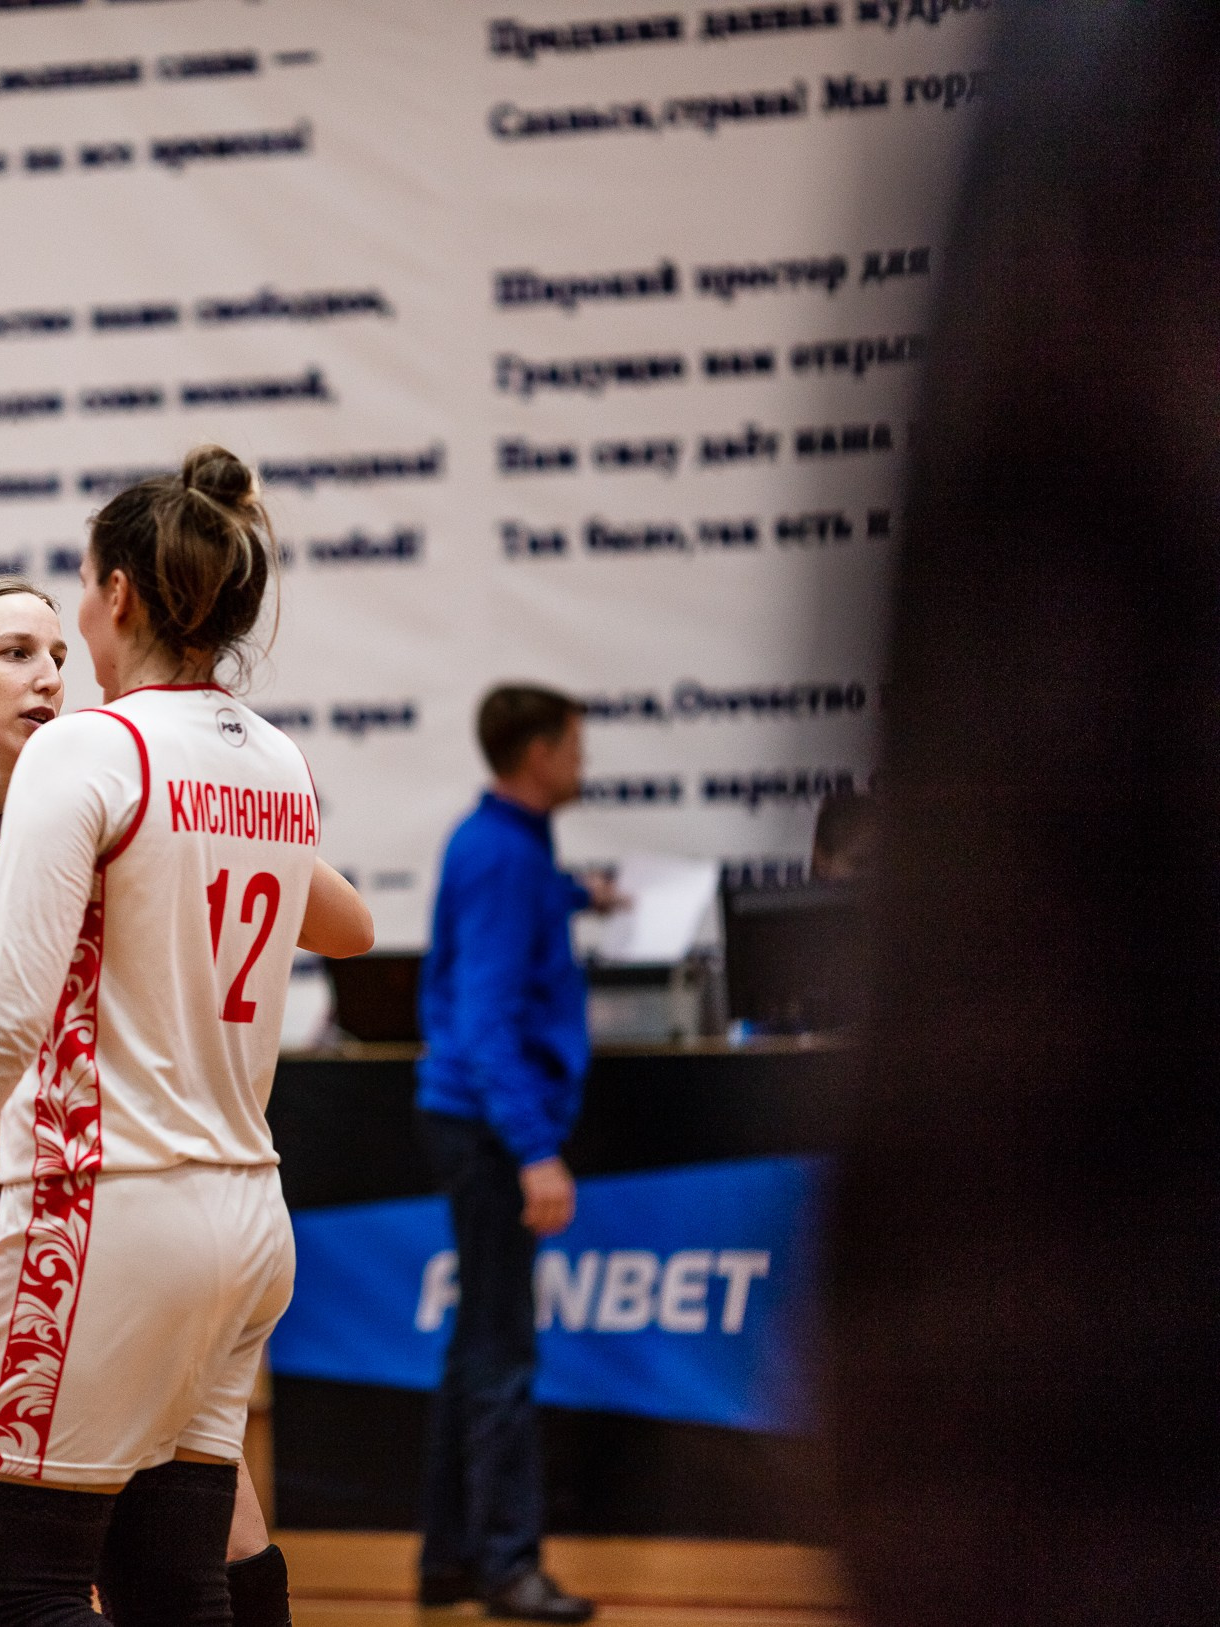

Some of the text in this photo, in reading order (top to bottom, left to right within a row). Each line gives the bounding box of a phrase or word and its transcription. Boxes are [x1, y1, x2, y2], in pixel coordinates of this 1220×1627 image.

[167, 779, 316, 847] КИСЛЮНИНА
[207, 868, 281, 1024] 12
[414, 1249, 771, 1335] FNBET
